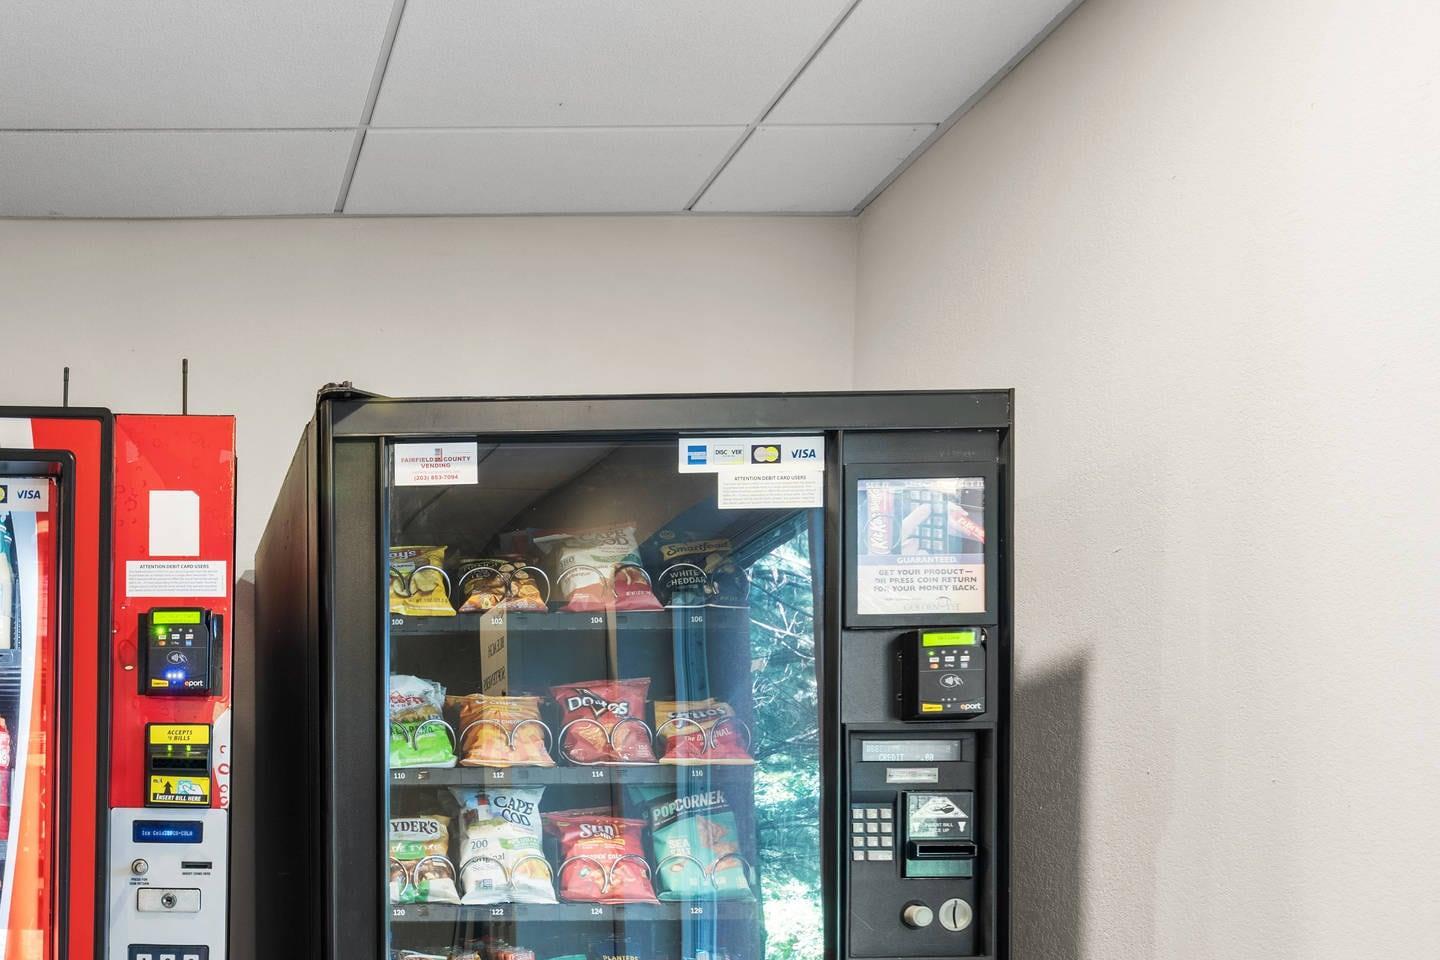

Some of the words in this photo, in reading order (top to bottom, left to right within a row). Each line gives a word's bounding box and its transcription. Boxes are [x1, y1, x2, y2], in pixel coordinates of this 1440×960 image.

[792, 449, 816, 459] VISA
[17, 490, 40, 499] VISA
[670, 569, 699, 578] WHITE
[392, 618, 404, 626] 100
[492, 617, 503, 625] 102
[591, 616, 603, 624] 104
[394, 772, 406, 780] 110
[493, 771, 505, 779] 112
[592, 770, 604, 778] 114
[494, 796, 534, 815] CAPE
[502, 809, 531, 826] COD
[391, 820, 438, 834] YDER'S
[579, 823, 616, 839] Sun
[471, 839, 488, 849] 200
[394, 908, 406, 916] 120
[492, 908, 504, 916] 122
